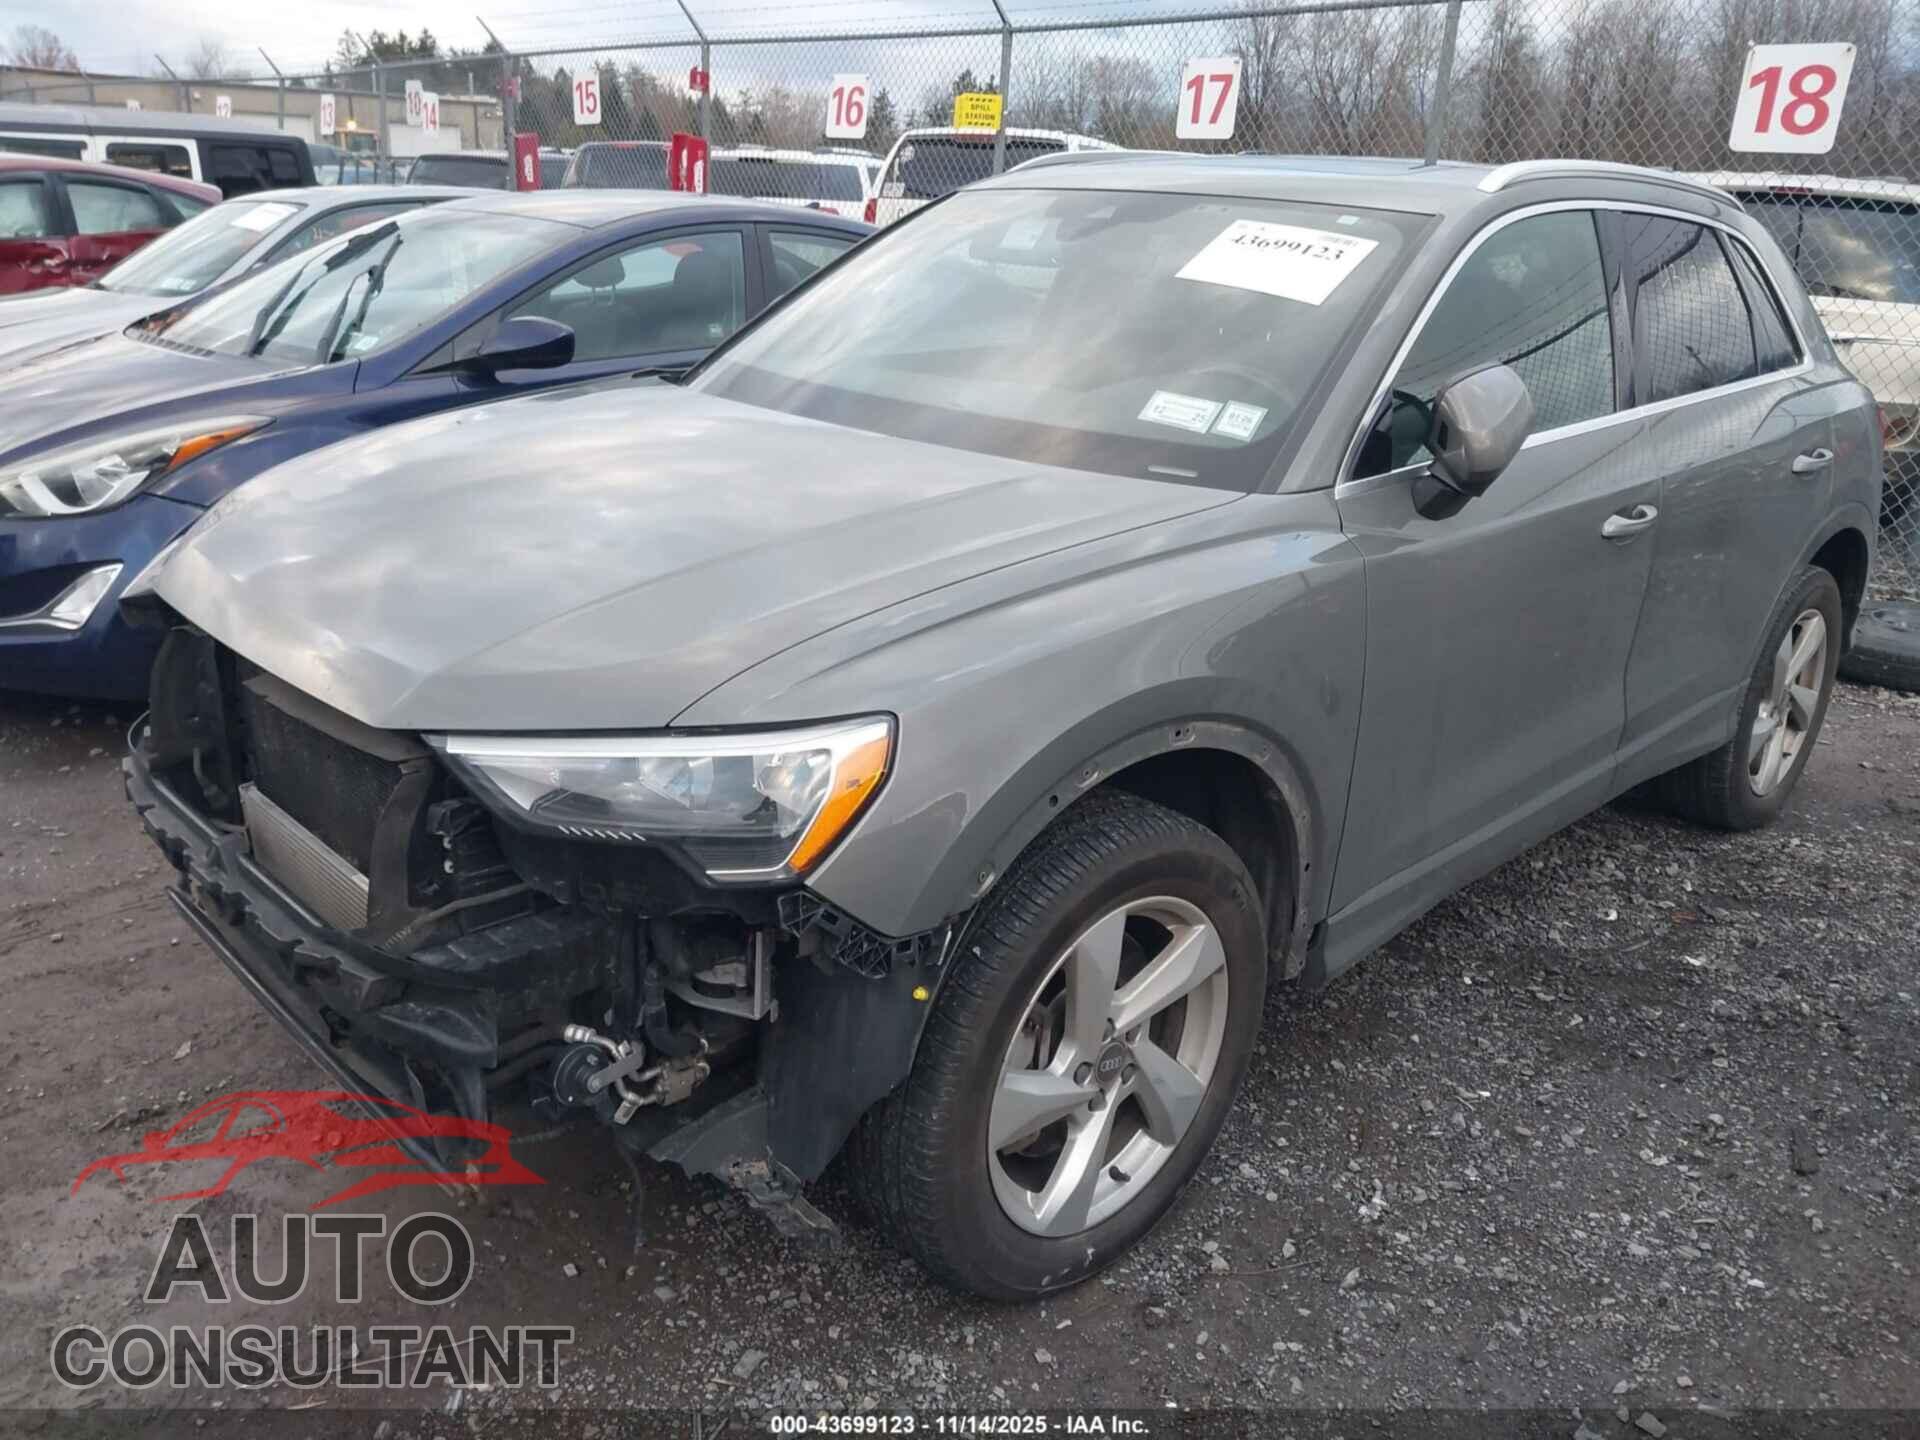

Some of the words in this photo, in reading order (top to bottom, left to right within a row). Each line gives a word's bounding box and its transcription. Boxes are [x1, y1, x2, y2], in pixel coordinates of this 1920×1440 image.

[575, 80, 598, 115] 15
[831, 85, 865, 127] 16
[1186, 74, 1233, 124] 17
[1749, 64, 1837, 135] 18
[423, 102, 437, 129] 14
[965, 112, 996, 121] STATION
[1232, 234, 1345, 261] 43699123
